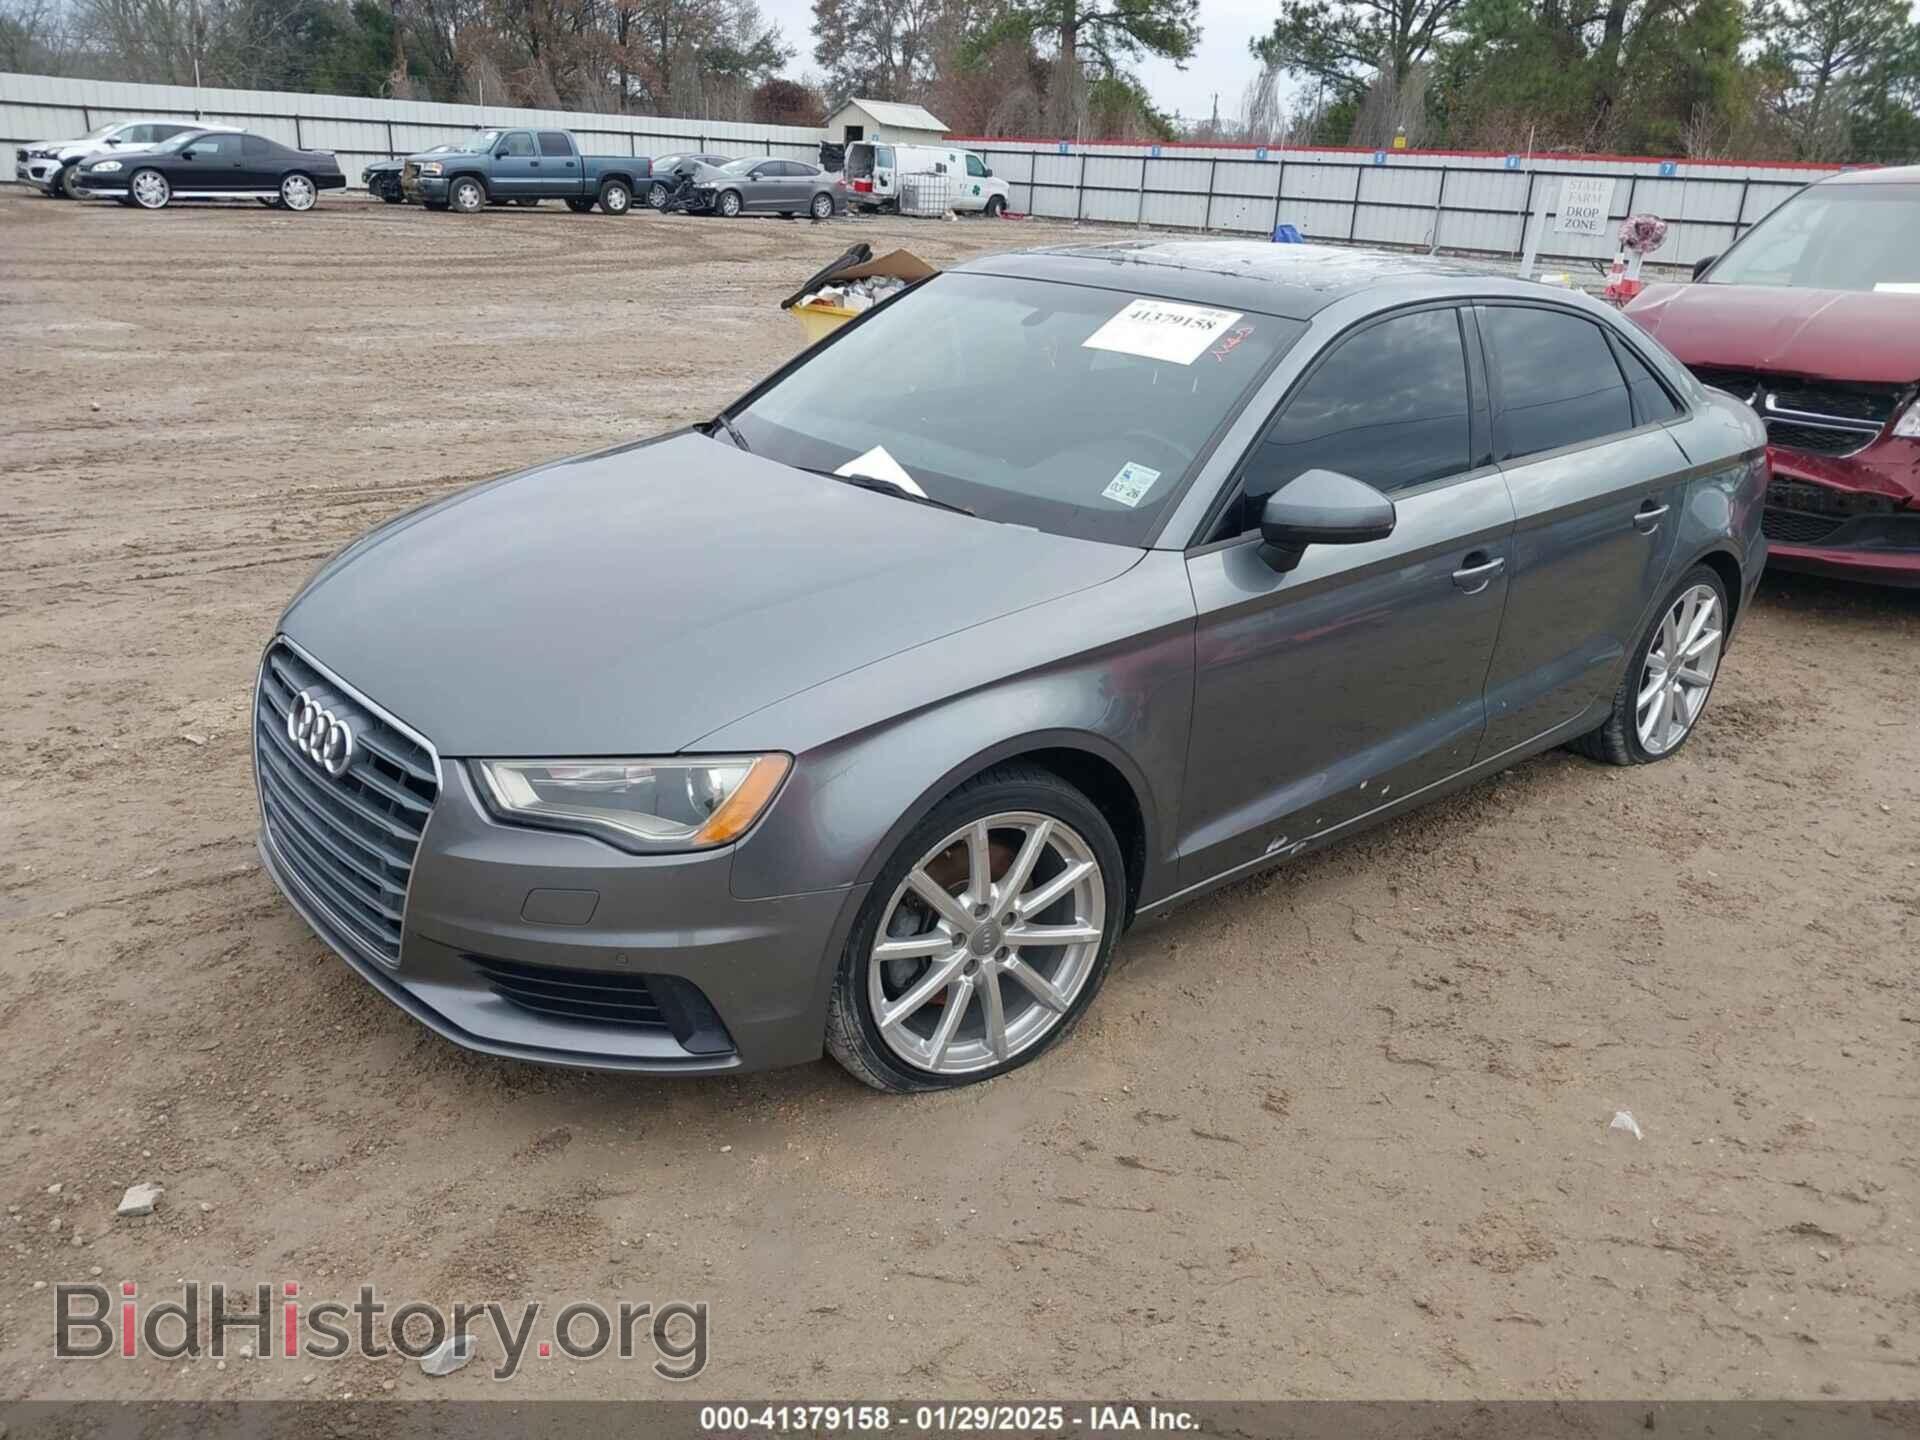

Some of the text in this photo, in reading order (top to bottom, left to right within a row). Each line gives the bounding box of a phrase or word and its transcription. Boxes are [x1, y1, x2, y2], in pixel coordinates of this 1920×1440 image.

[1568, 179, 1606, 193] STATE
[1566, 206, 1599, 218] DROP
[1565, 218, 1597, 230] ZONE
[1129, 310, 1217, 330] 41379158
